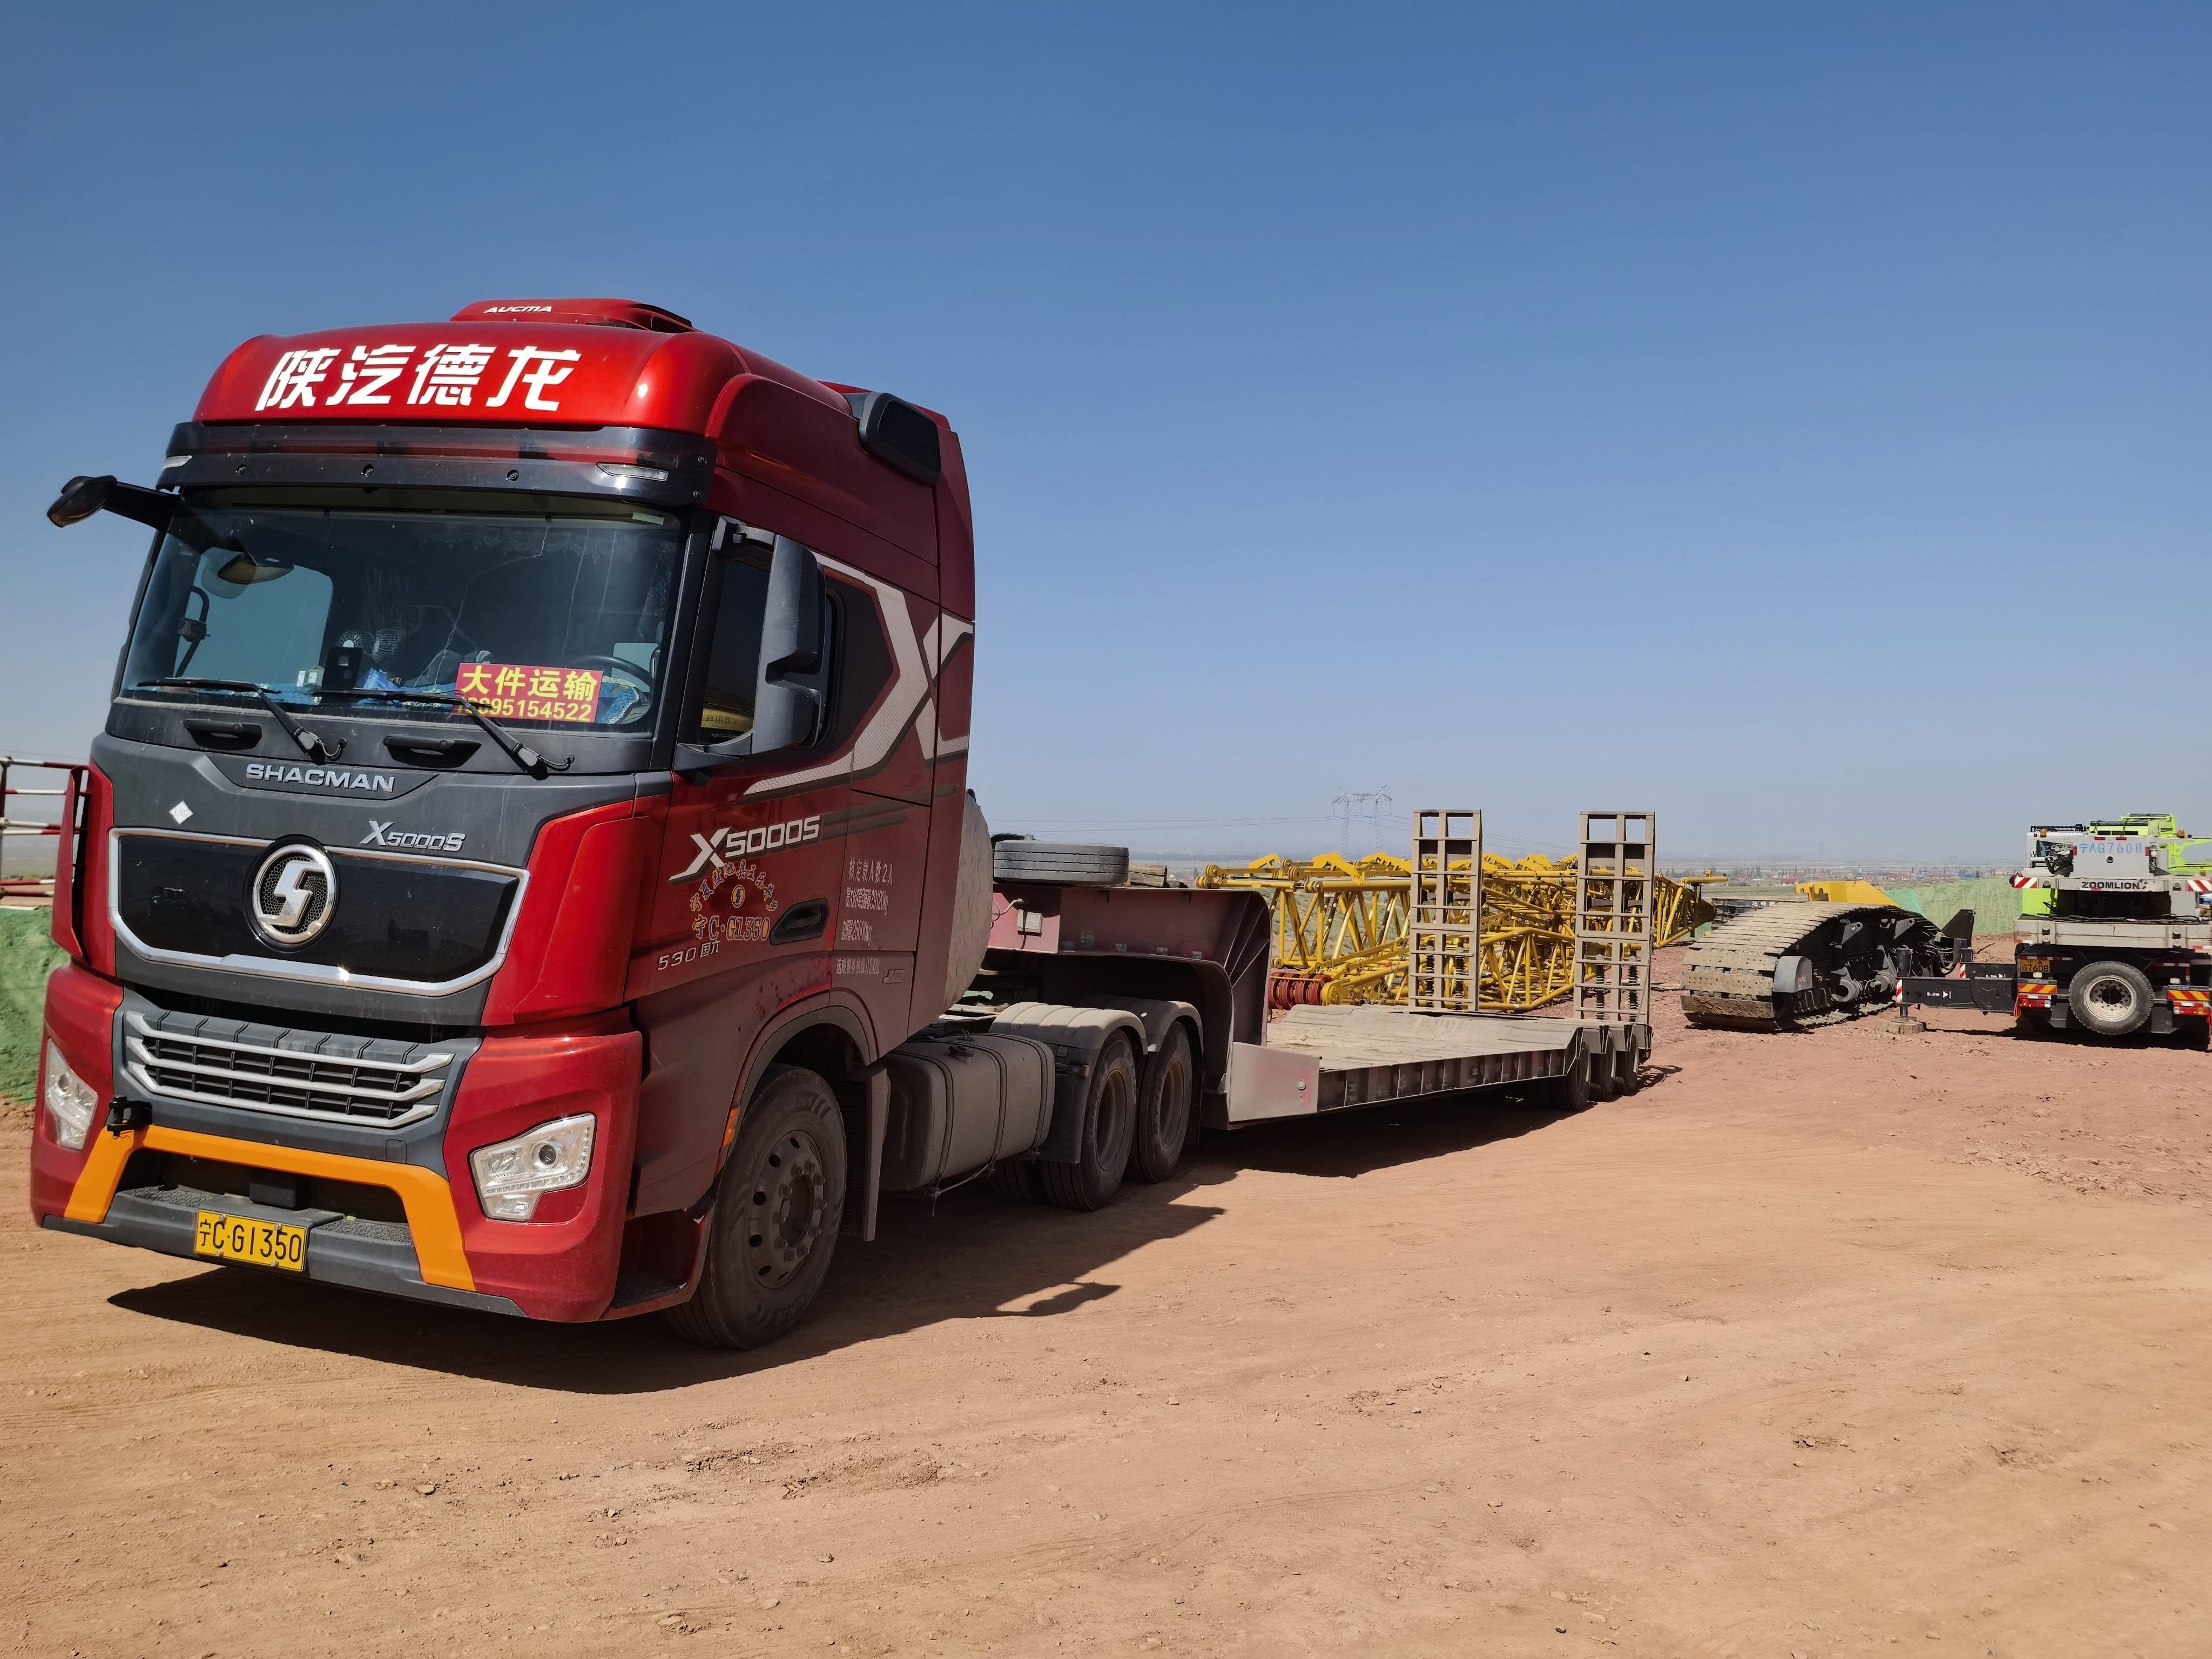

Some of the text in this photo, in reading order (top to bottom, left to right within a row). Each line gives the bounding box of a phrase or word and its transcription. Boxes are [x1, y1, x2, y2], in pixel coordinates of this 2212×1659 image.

[255, 343, 582, 412] 陕汽德龙
[461, 665, 598, 702] 大件运输
[246, 763, 395, 792] SHACMAN
[359, 820, 466, 852] X5000S
[669, 815, 820, 881] X5000S
[2079, 842, 2142, 854] 宁AG7608
[848, 857, 893, 886] 核定载人数2人
[2081, 881, 2140, 889] ZOOMLION
[657, 947, 697, 970] 530
